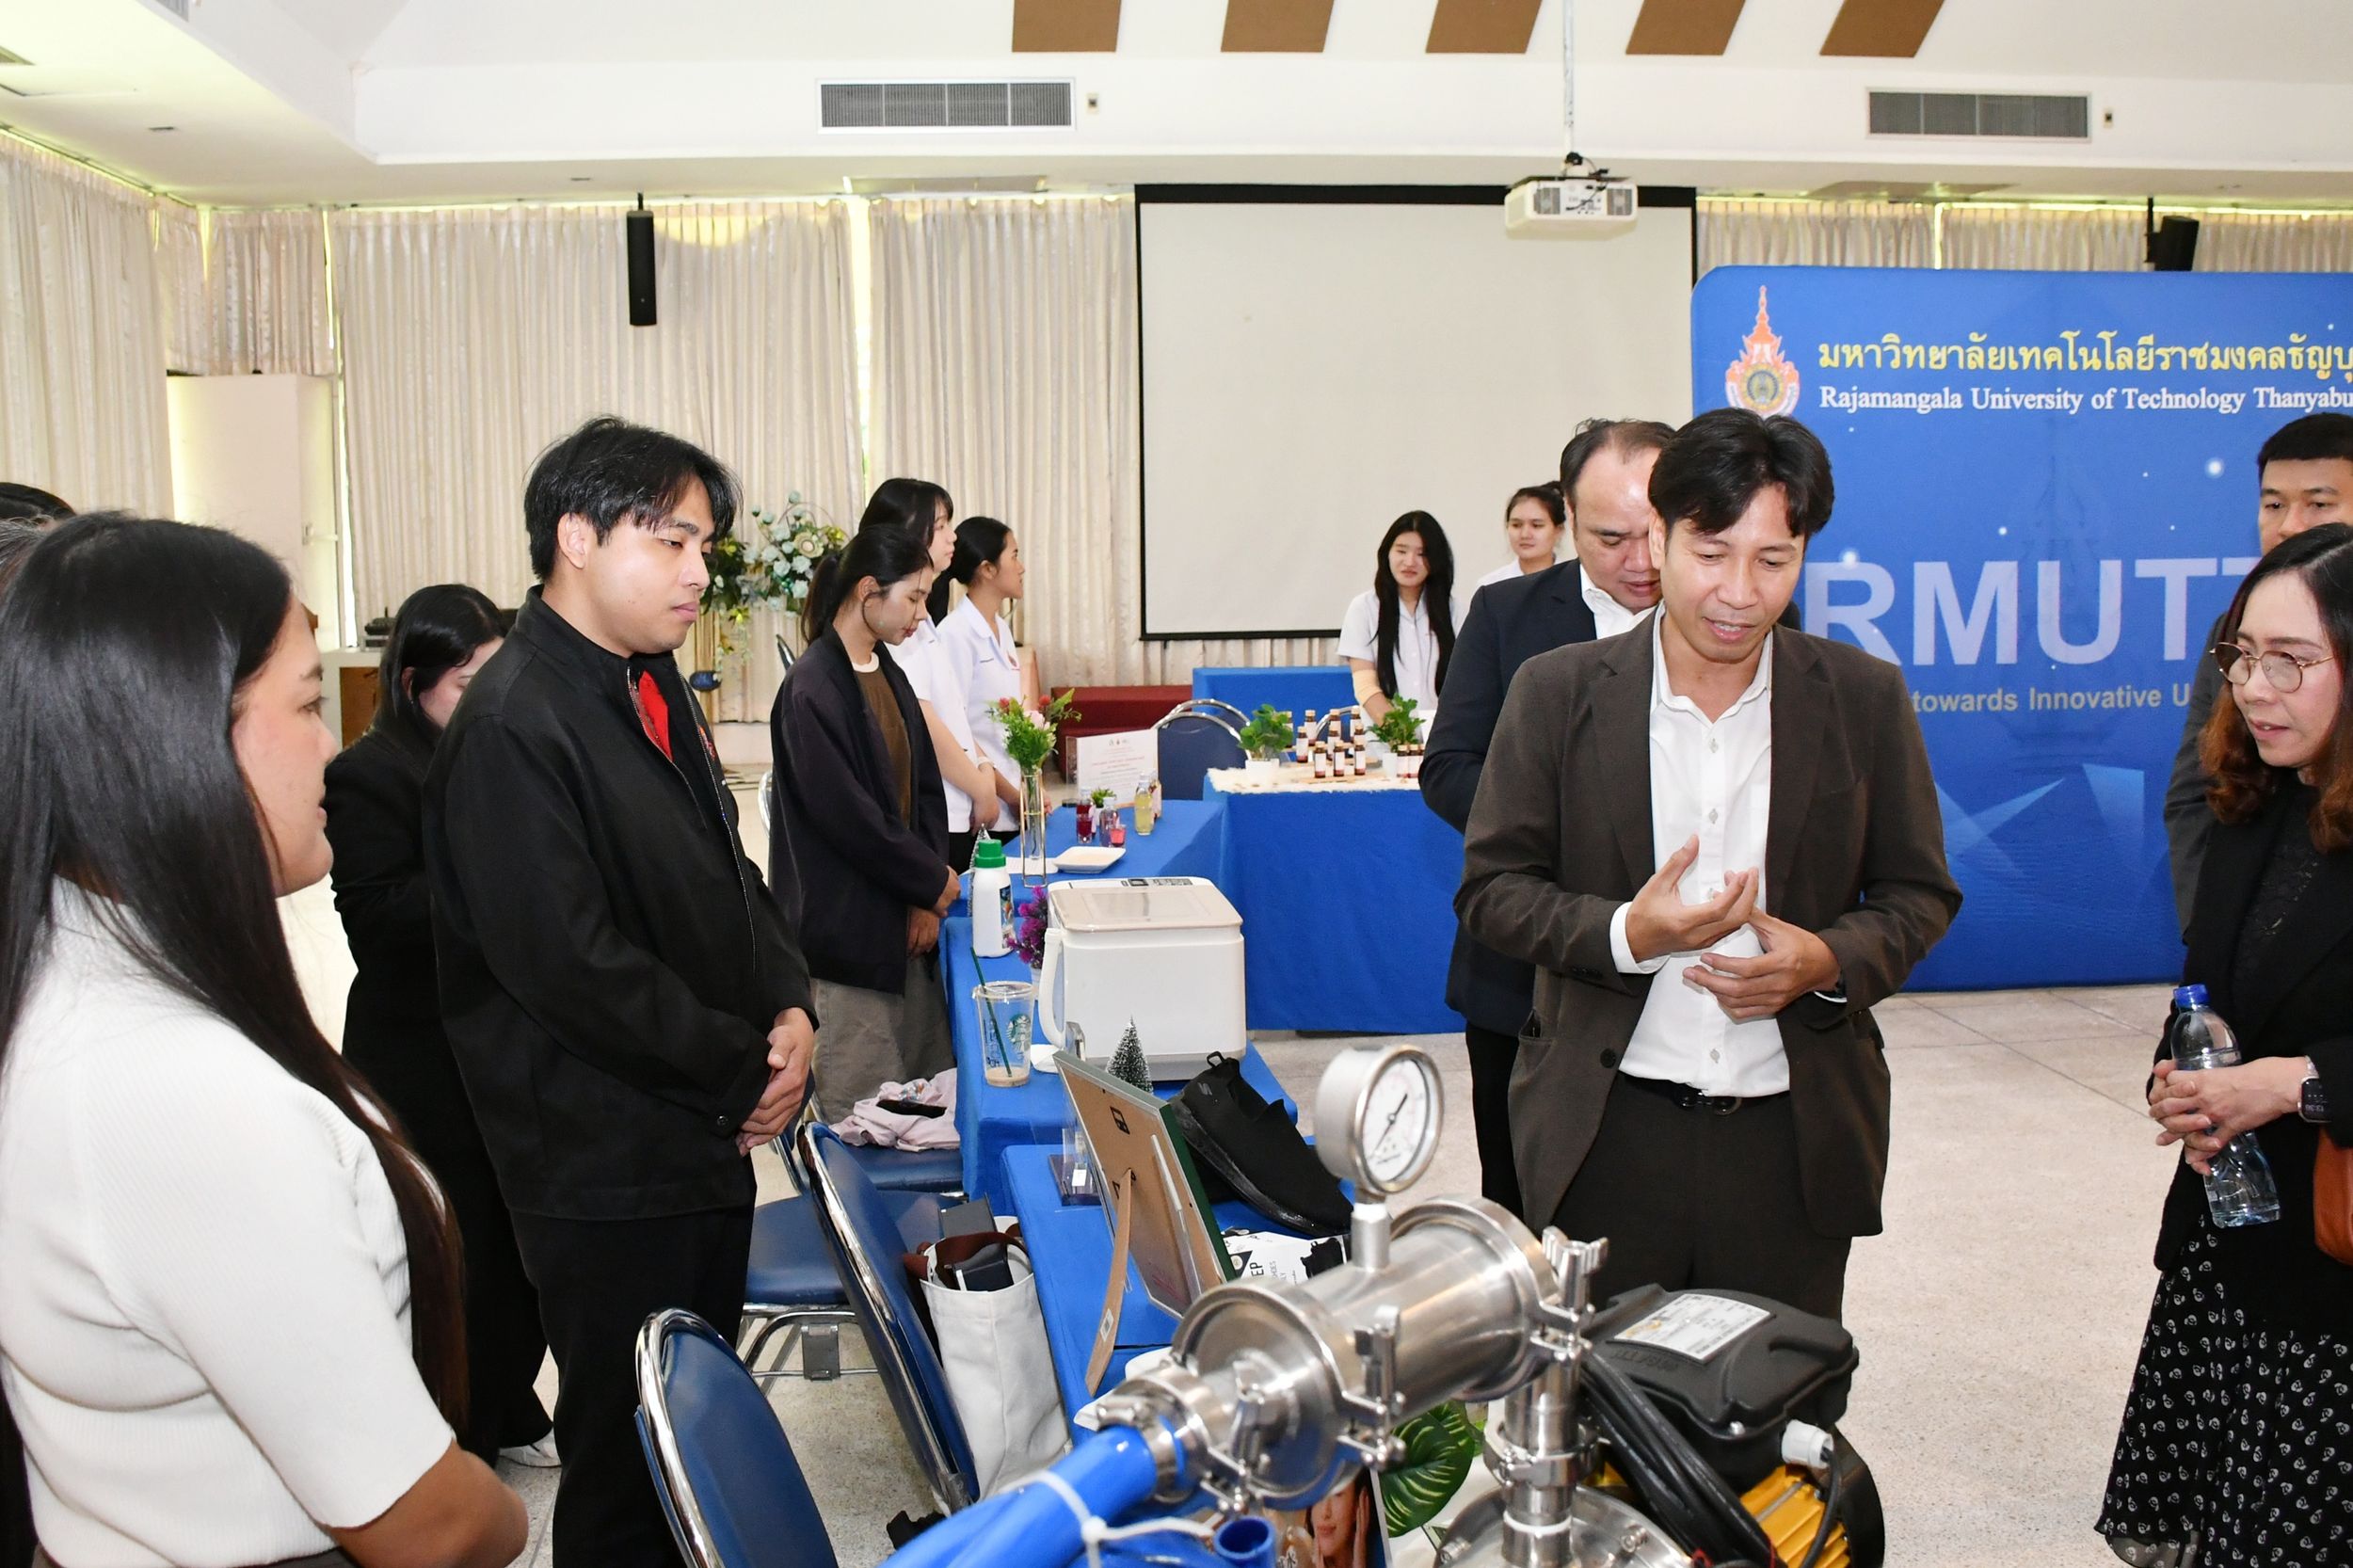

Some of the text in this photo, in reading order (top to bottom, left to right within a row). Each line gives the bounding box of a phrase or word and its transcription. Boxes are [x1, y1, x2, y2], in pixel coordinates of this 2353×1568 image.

[1819, 386, 1963, 414] Rajamangala
[1971, 387, 2083, 414] University
[2091, 388, 2117, 409] of
[2121, 387, 2246, 414] Technology
[2253, 386, 2353, 412] Thanyabu
[1805, 558, 2262, 666] RMUT
[1912, 688, 2019, 712] towards
[2029, 684, 2161, 711] Innovative
